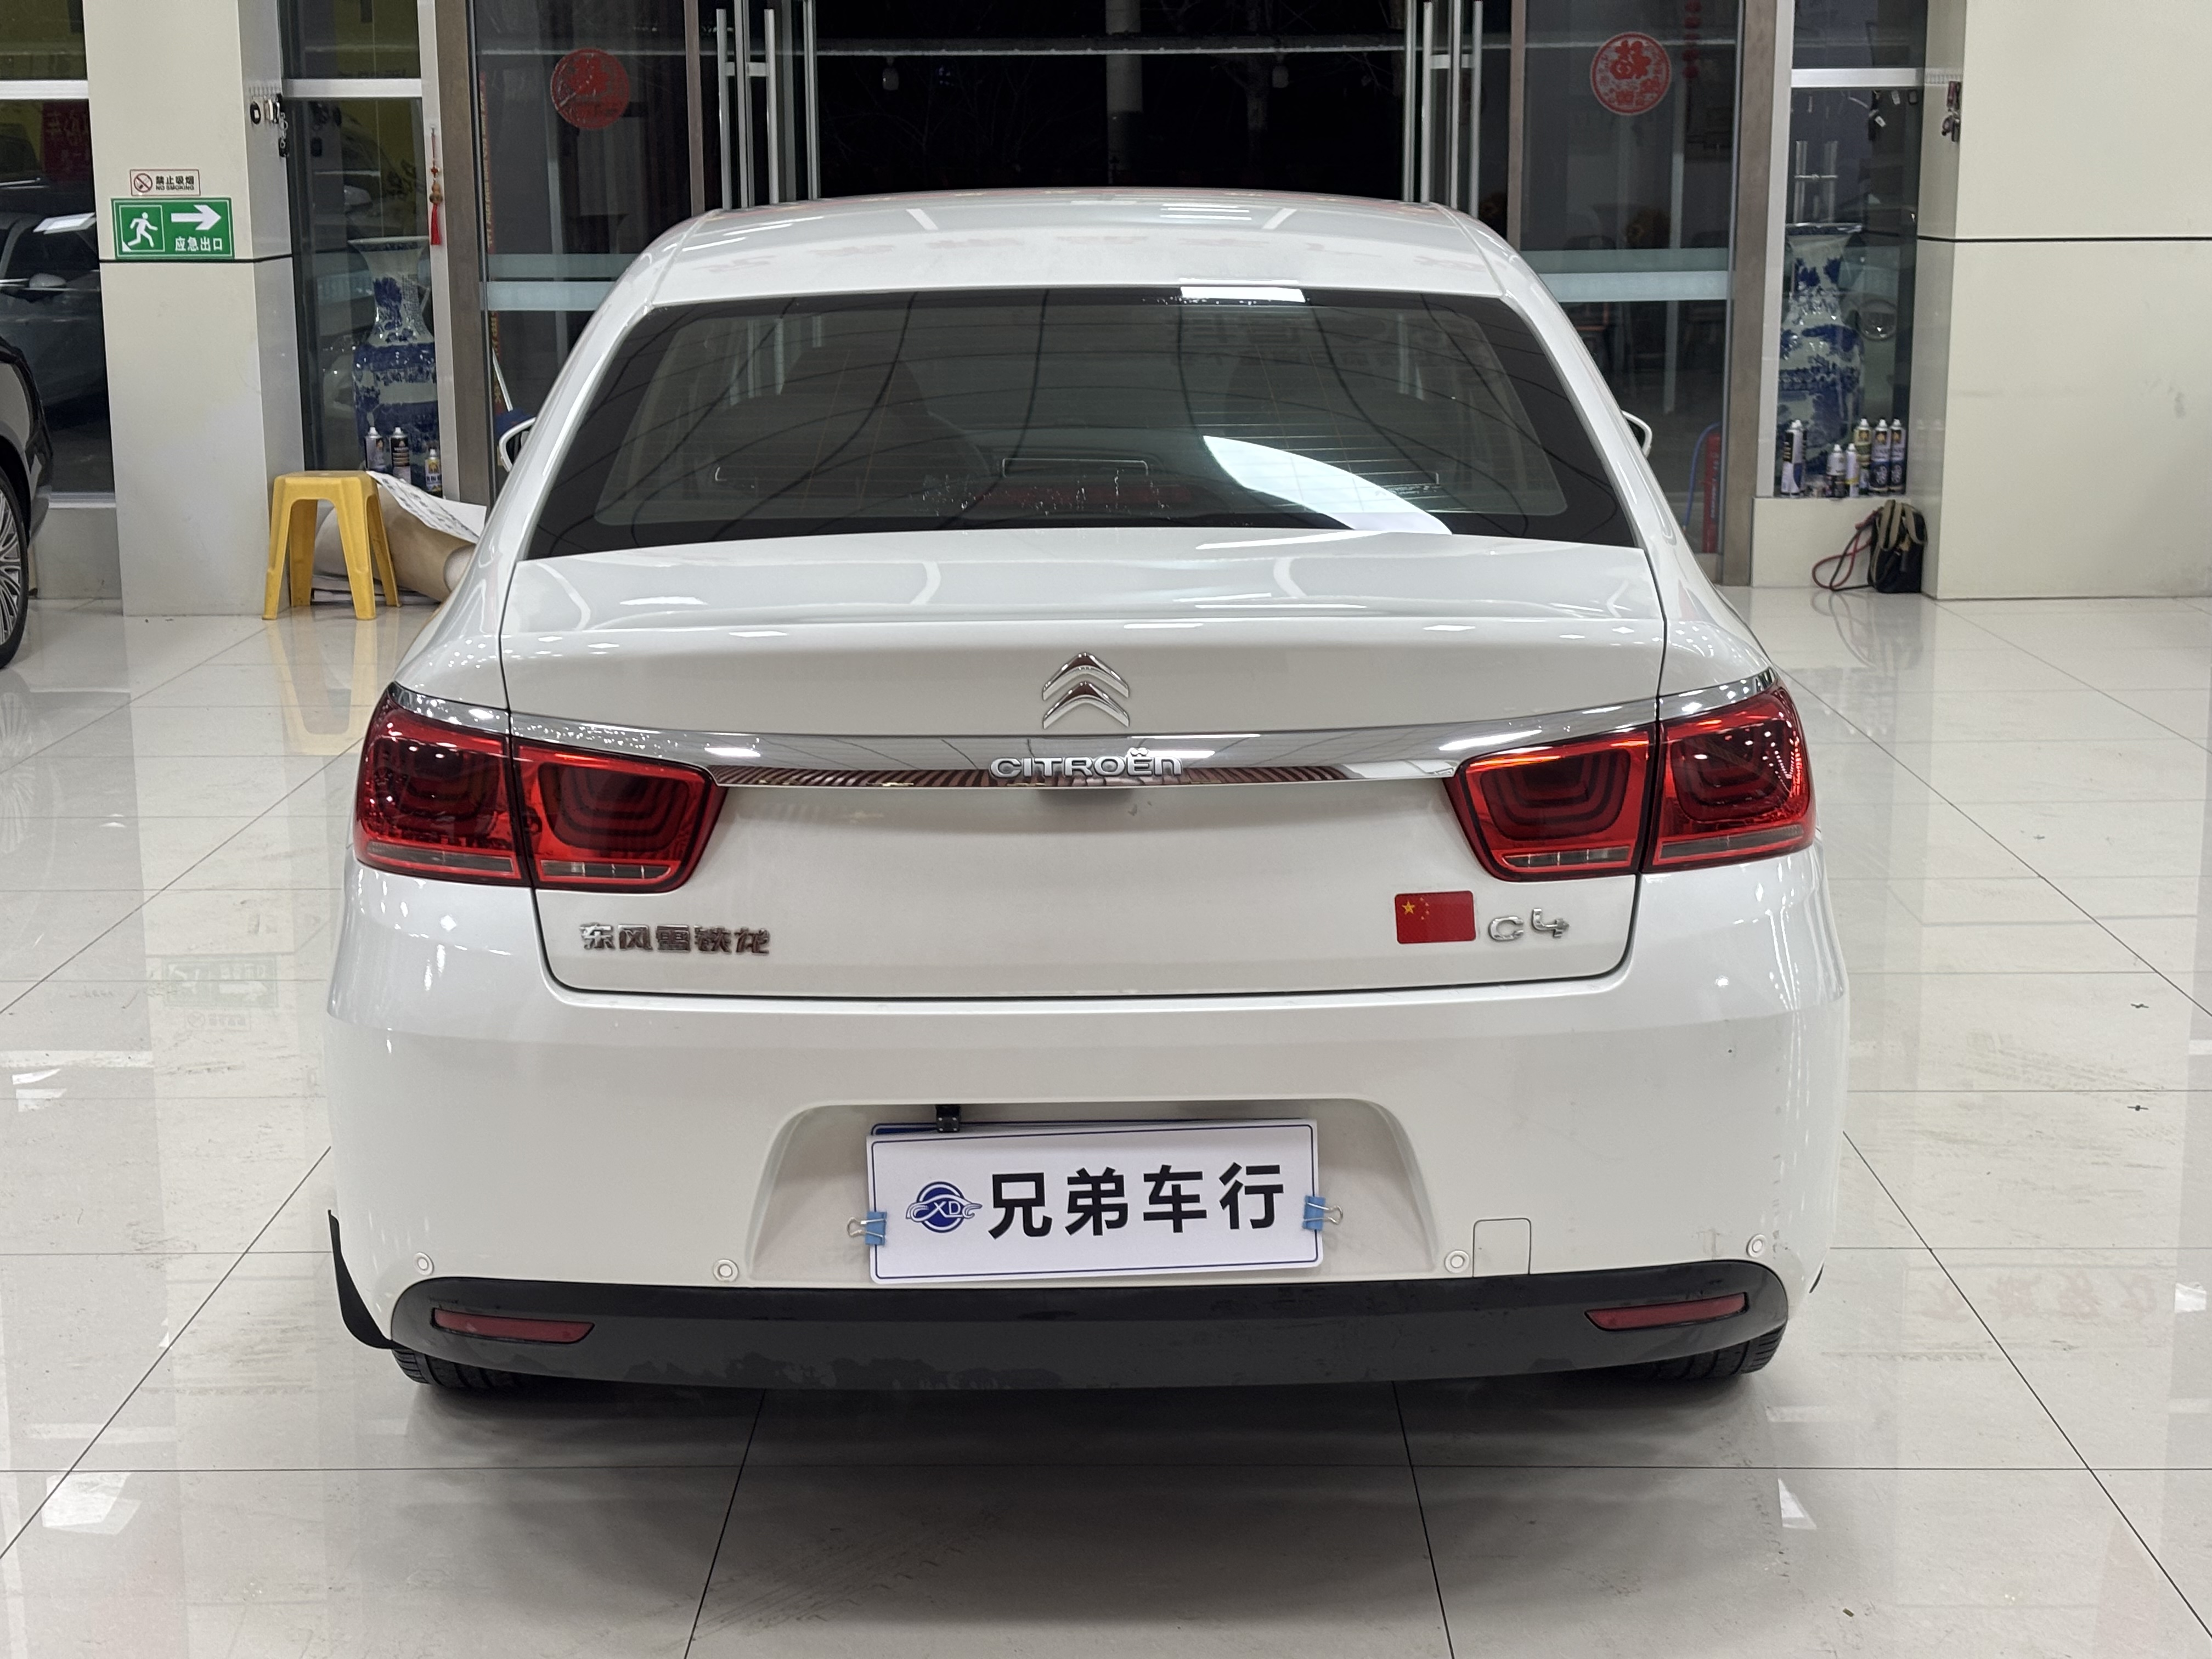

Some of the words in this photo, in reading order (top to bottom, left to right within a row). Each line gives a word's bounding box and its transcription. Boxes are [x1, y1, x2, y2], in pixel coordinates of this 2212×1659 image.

[156, 176, 194, 185] 禁止吸烟
[175, 236, 222, 251] 应急出口
[579, 923, 770, 953] 东风雪铁龙
[1488, 908, 1570, 942] C4
[989, 1162, 1284, 1239] 兄弟车行
